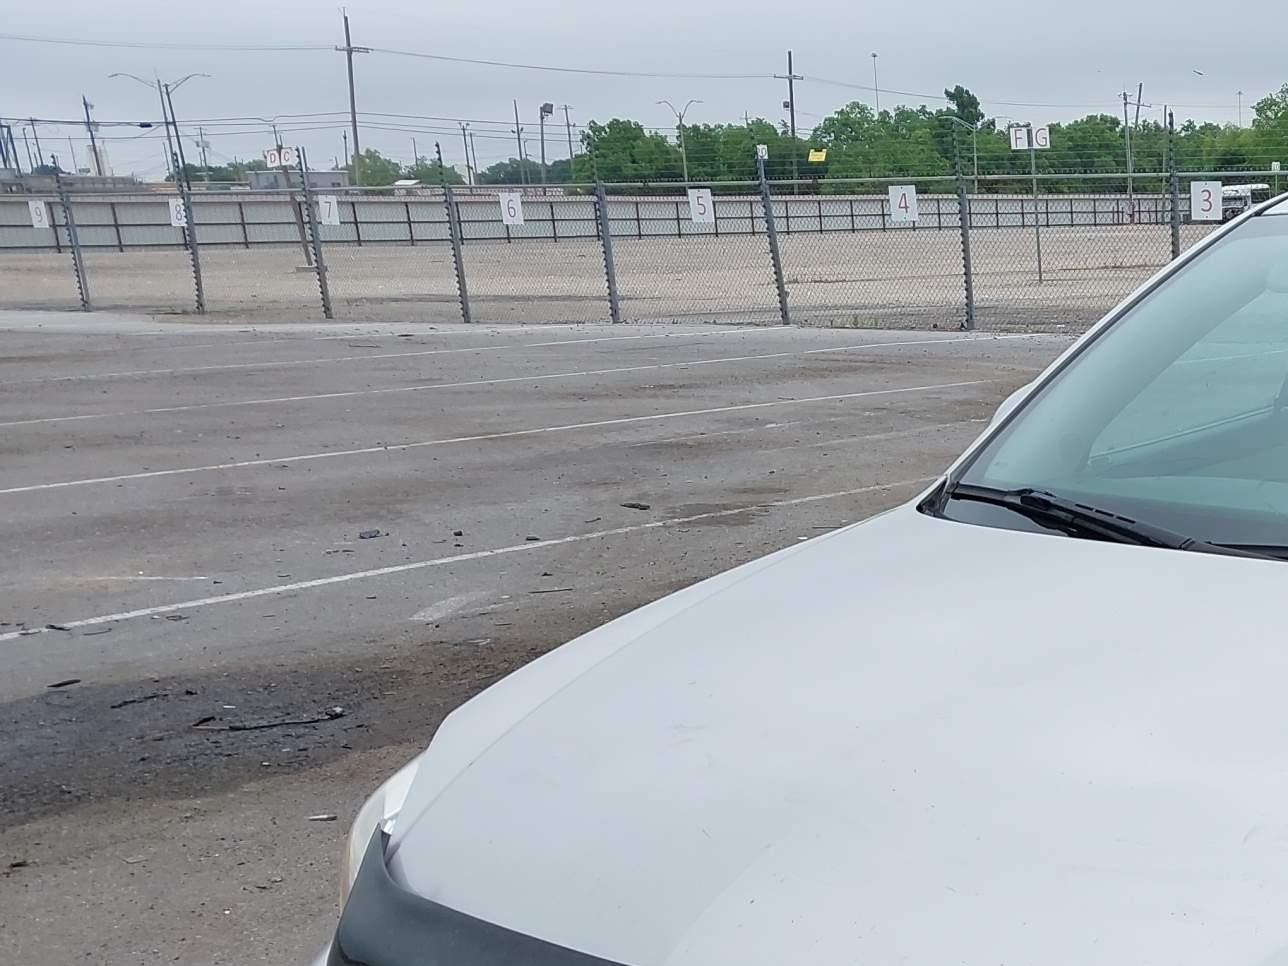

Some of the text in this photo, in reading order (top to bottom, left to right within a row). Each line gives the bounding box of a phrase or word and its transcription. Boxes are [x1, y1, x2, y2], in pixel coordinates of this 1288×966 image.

[1015, 128, 1023, 148] F
[1035, 128, 1048, 147] G
[324, 201, 332, 218] 7
[507, 199, 516, 218] 6
[696, 196, 707, 215] 5
[898, 193, 910, 214] 4
[1200, 189, 1213, 212] 3
[34, 207, 42, 222] 9
[174, 204, 184, 221] 8
